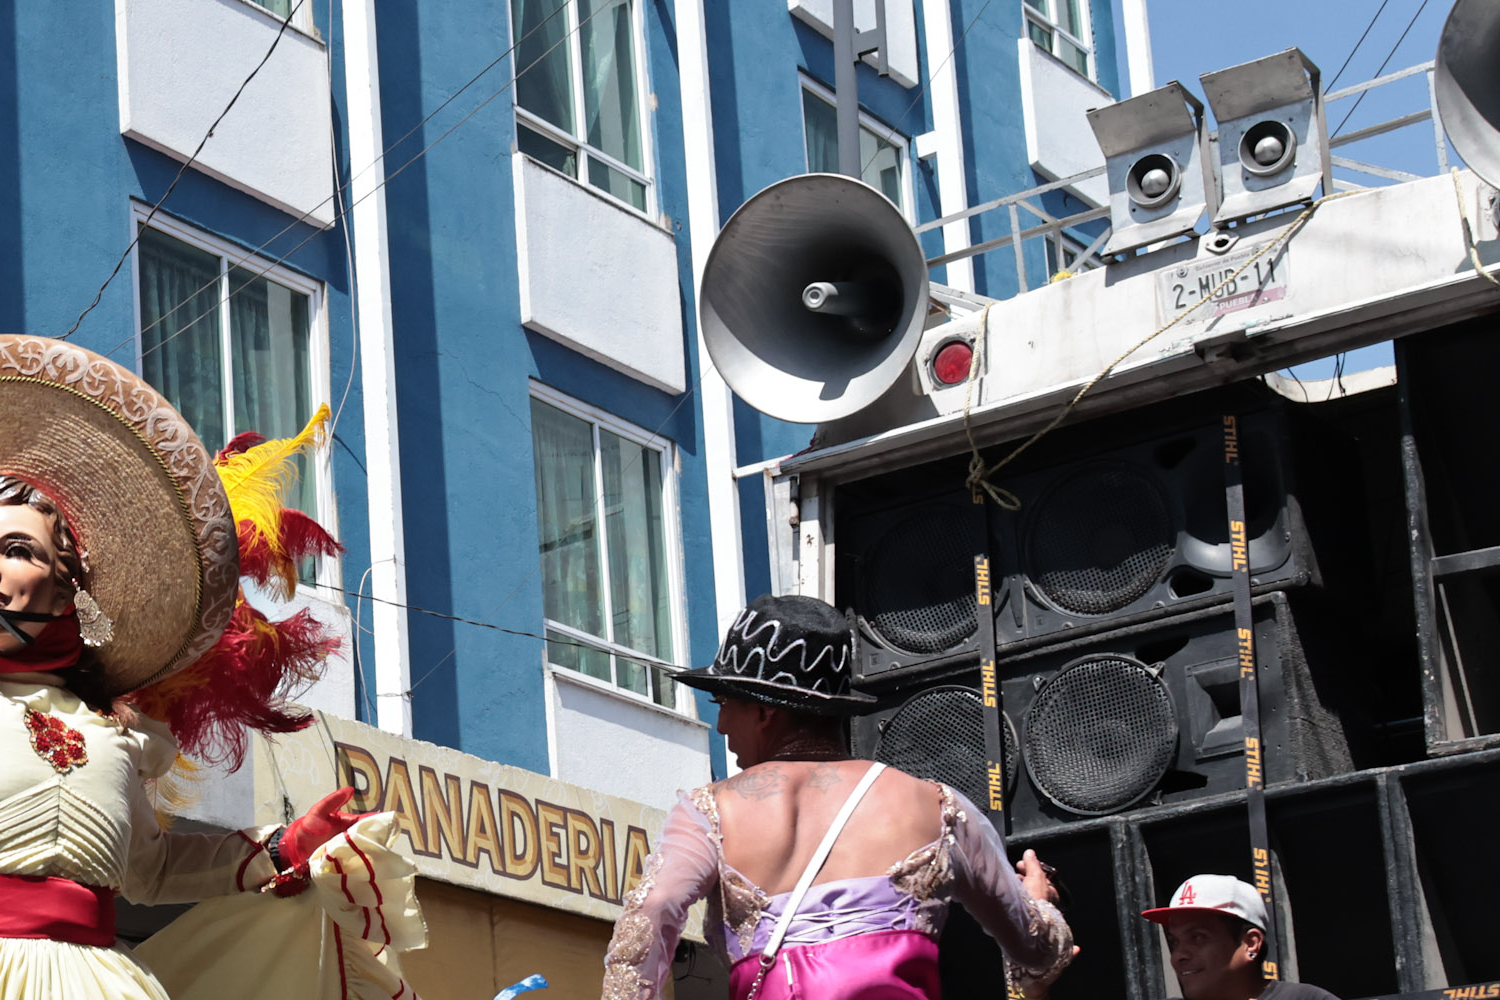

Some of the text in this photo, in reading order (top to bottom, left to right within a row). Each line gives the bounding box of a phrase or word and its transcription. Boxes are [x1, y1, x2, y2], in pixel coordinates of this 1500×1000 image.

[1223, 415, 1240, 466] STIHL
[1230, 520, 1248, 574] STIHL
[975, 557, 991, 606] STIHL
[1237, 627, 1255, 681] STIHL
[981, 658, 997, 709] STIHL
[986, 760, 1003, 811] STIHL
[1244, 736, 1264, 791] STIHL
[334, 741, 651, 907] PANADERIA
[1179, 880, 1197, 906] LA
